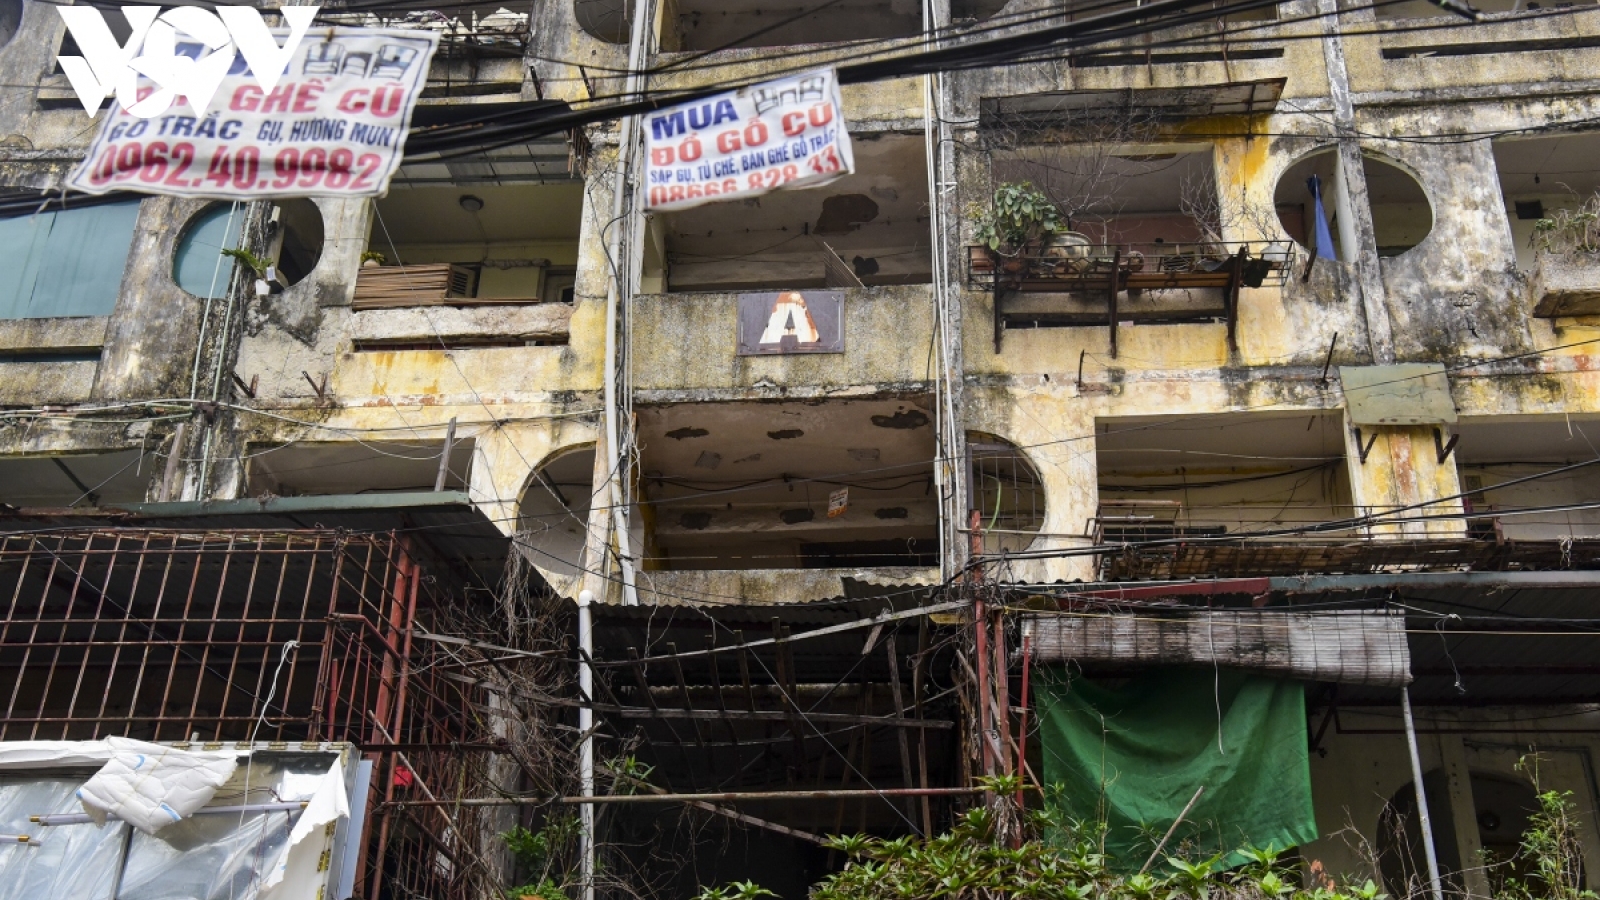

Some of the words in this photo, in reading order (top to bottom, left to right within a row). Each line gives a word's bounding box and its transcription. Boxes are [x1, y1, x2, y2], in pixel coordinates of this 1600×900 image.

[336, 82, 405, 118] CŨ
[651, 99, 739, 140] MUA
[349, 121, 394, 147] MUN
[716, 115, 769, 154] GỖ
[781, 102, 833, 137] CŨ
[90, 141, 382, 190] 0962.40.9982
[759, 292, 819, 343] A
